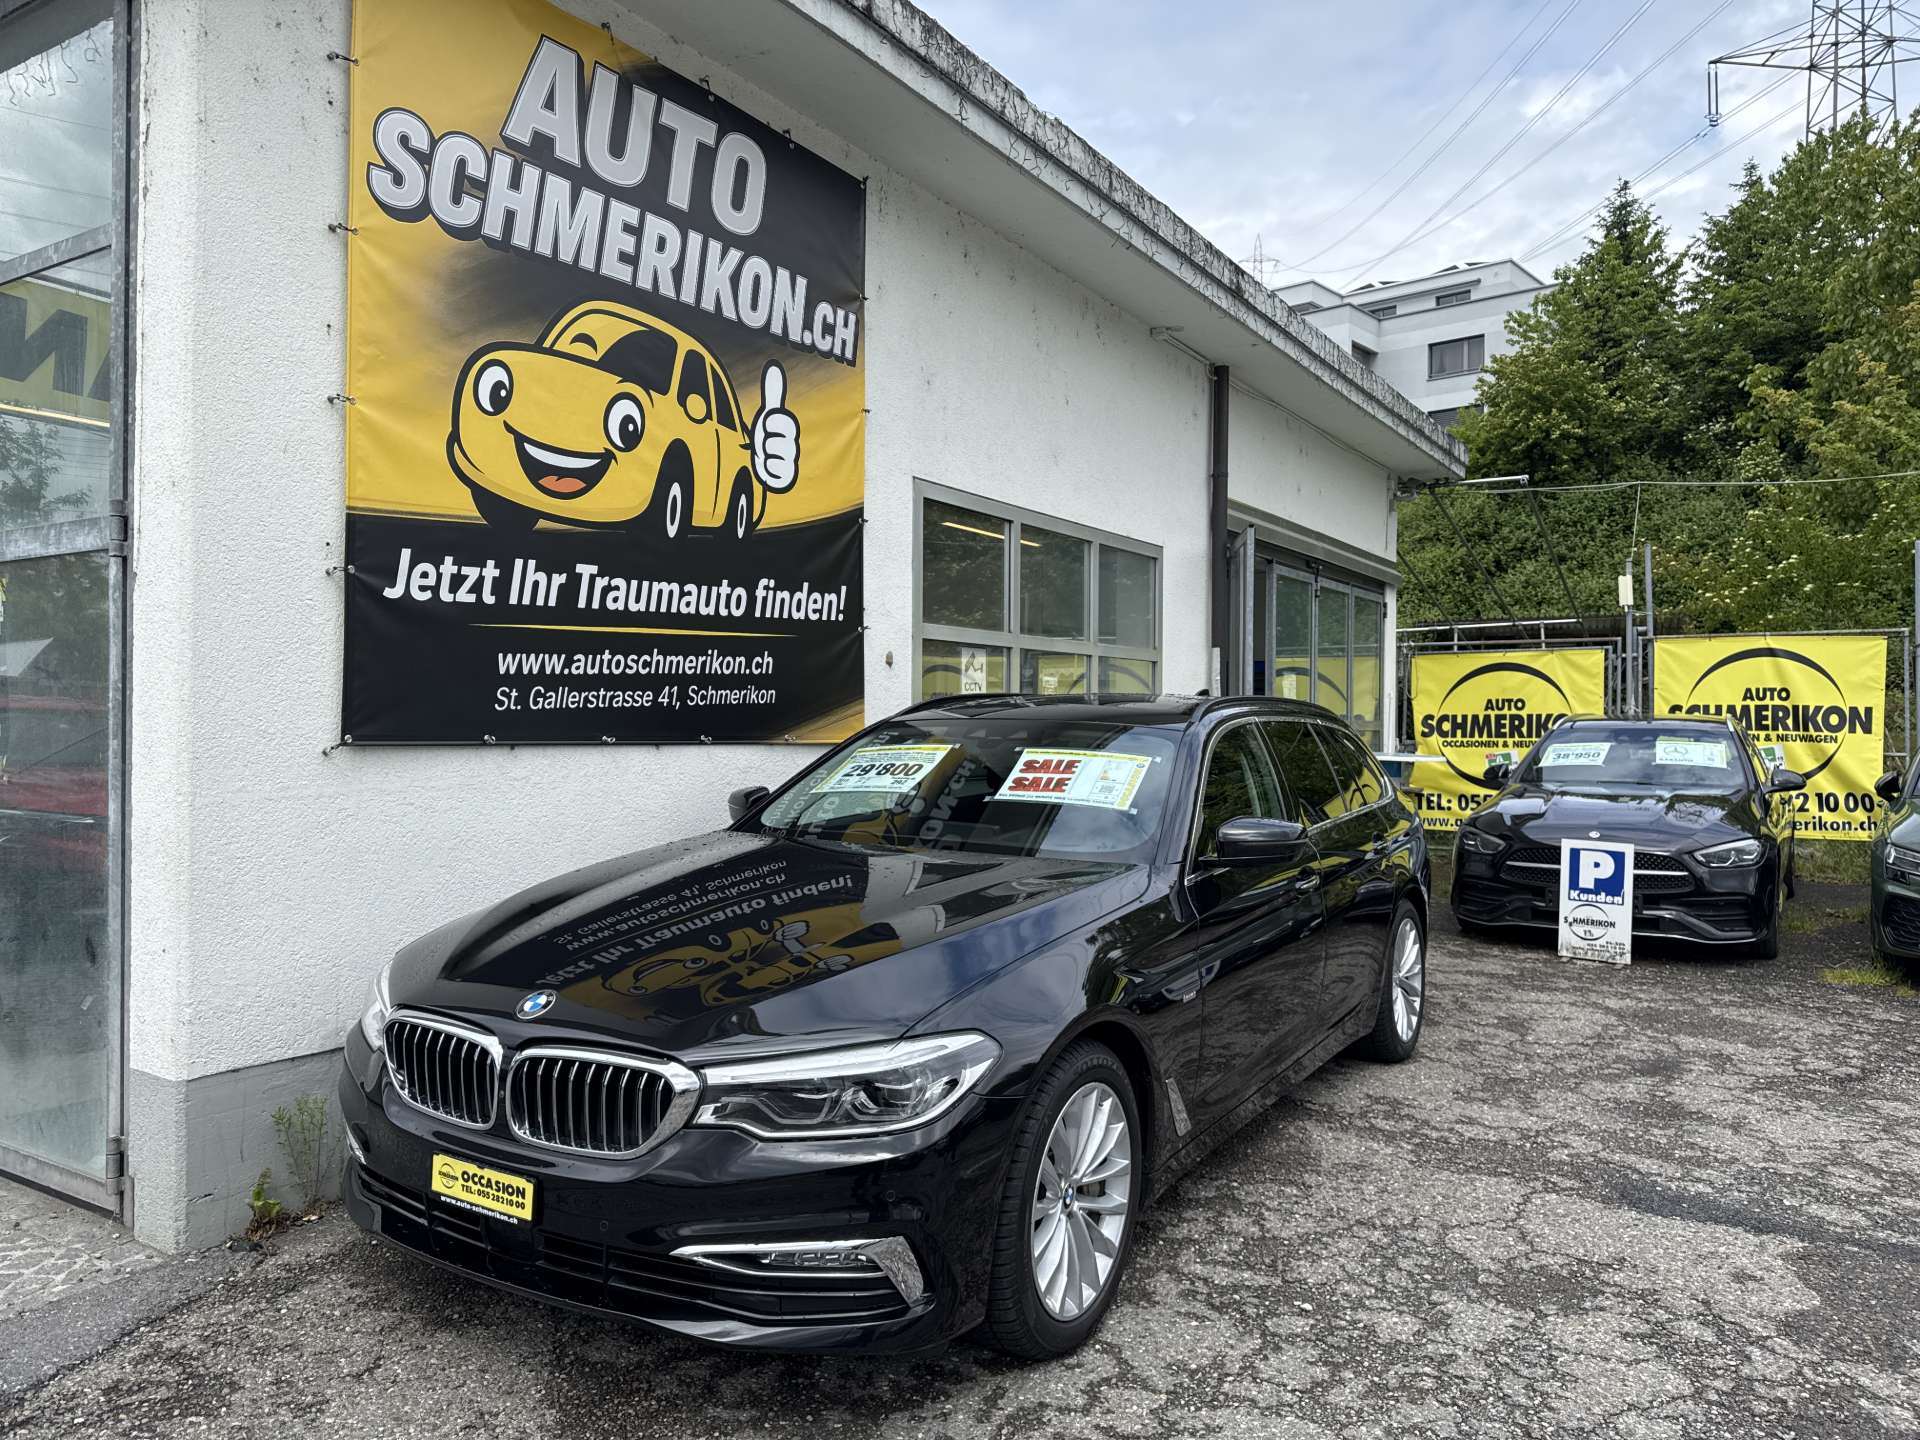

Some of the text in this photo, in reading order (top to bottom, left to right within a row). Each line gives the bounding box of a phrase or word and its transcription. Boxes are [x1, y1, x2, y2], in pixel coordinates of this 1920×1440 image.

[502, 34, 768, 236] AUTO
[368, 109, 857, 362] SCHMERIKON.CH
[382, 547, 847, 622] Jetzt Ihr Traumauto finden!
[497, 649, 774, 677] www.autoschmerikon.ch
[494, 683, 776, 711] St. Gallerstrasse 41, Schmerikon
[964, 682, 984, 693] CCTV
[1742, 687, 1791, 702] AUTO
[1484, 698, 1526, 711] AUTO
[1420, 713, 1569, 739] SCHMERIK
[1442, 739, 1499, 748] OCCASIONEN
[1501, 739, 1509, 748] &
[1763, 733, 1773, 743] &
[1776, 733, 1838, 744] NEUWAGEN
[841, 763, 924, 778] 29'800
[1019, 758, 1082, 775] SALE
[1007, 776, 1073, 793] SALE
[1415, 793, 1452, 811] TEL:
[1814, 792, 1840, 813] 10
[1843, 791, 1875, 814] 00
[1578, 849, 1615, 889] P
[1569, 889, 1624, 905] Kunden
[461, 1170, 526, 1200] OCCASION
[461, 1184, 477, 1196] TEL:
[476, 1187, 491, 1200] 055
[514, 1199, 526, 1210] 00
[440, 1195, 518, 1225] www.auto-schmerikon.ch
